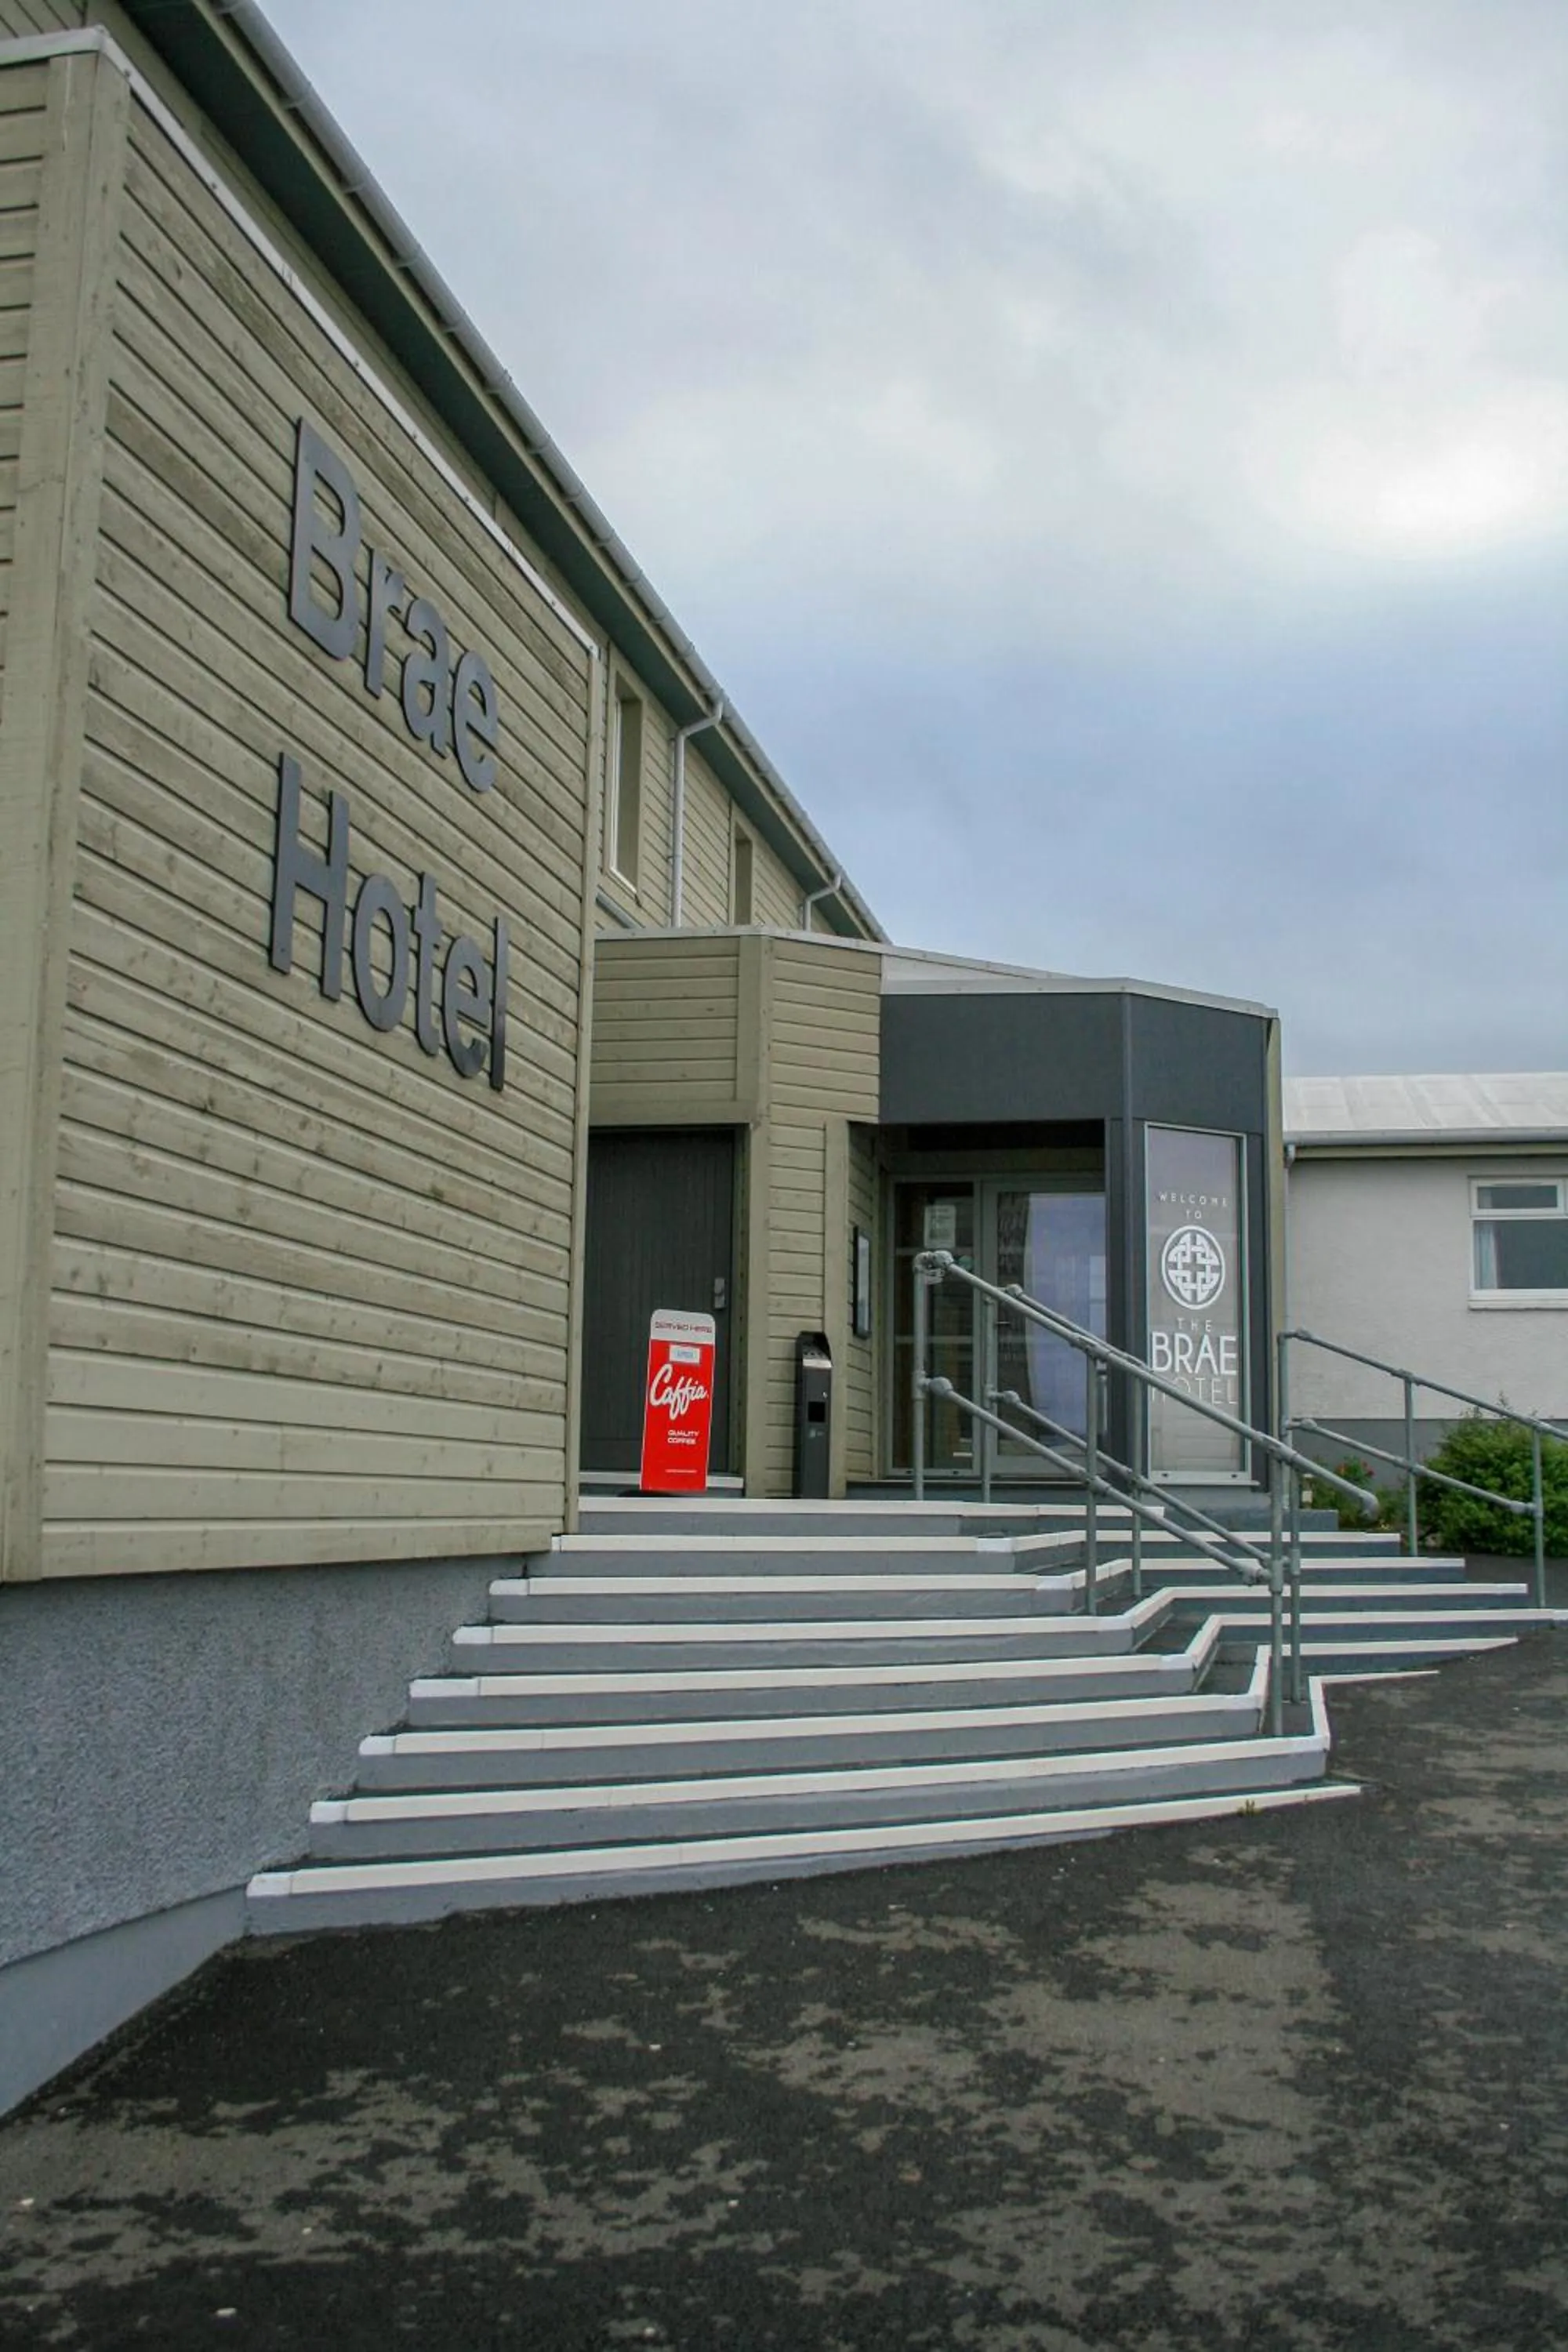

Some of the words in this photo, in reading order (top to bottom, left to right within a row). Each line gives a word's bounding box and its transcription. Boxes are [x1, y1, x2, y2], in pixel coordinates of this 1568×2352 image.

[287, 416, 499, 794] Brae
[270, 751, 510, 1093] Hotel
[1160, 1192, 1227, 1207] WELCOME
[1185, 1209, 1202, 1220] TO
[1177, 1317, 1211, 1333] THE
[1152, 1331, 1237, 1376] BRAE
[649, 1363, 707, 1421] Caffia
